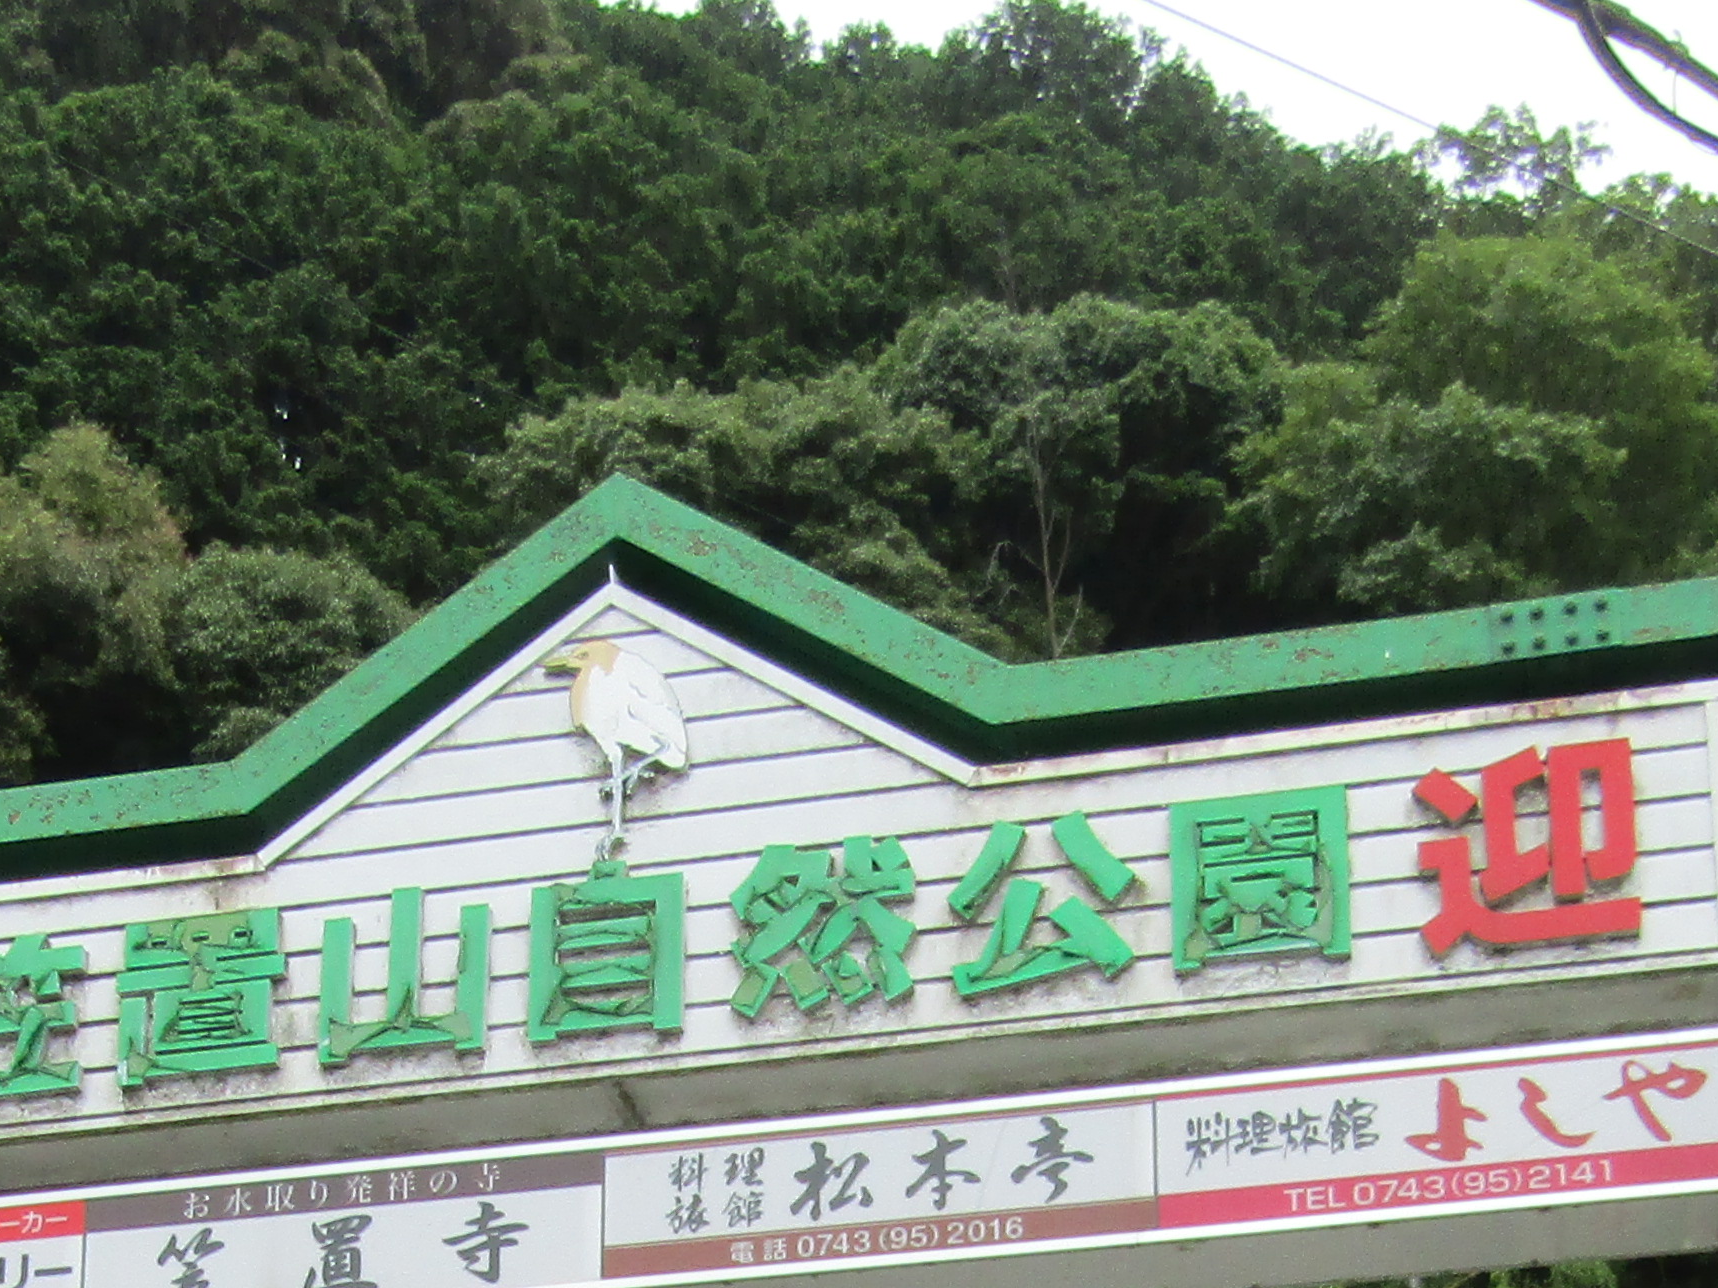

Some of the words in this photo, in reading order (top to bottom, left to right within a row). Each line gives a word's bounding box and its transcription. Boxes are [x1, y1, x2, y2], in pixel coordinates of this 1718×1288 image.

[1412, 737, 1641, 957] 迎
[1404, 1059, 1708, 1162] よしや
[183, 1163, 501, 1219] お水取り発祥の寺
[790, 1116, 1094, 1221] 松本亭
[1284, 1185, 1345, 1212] TEL
[1353, 1159, 1614, 1205] 0743(95)2141
[729, 1239, 788, 1264] 電話
[797, 1217, 1024, 1258] 0743(95)2016
